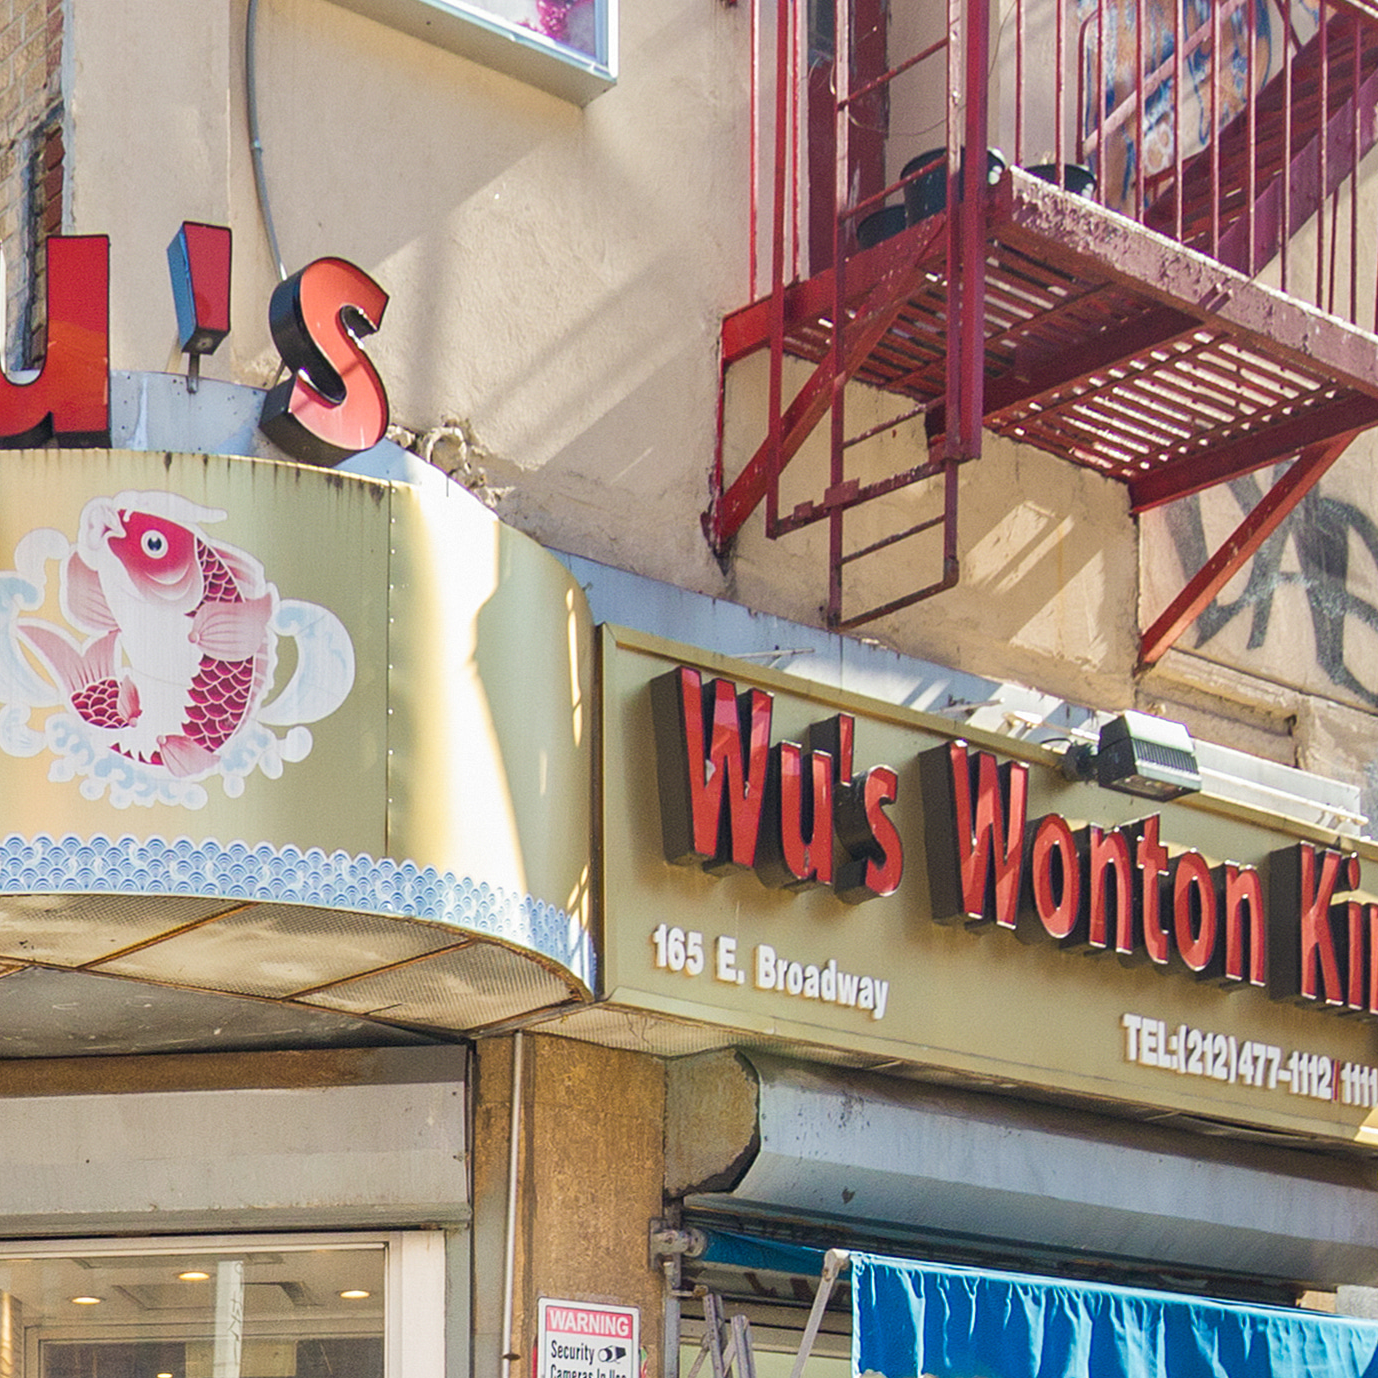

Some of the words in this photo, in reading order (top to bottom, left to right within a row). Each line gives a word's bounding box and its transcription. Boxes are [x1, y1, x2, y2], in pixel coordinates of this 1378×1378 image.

[652, 666, 904, 899] Wu's
[920, 739, 1265, 988] Wonton
[652, 924, 705, 974] 165
[715, 937, 747, 985] E.
[755, 945, 890, 1020] Broadway
[549, 1309, 629, 1336] WARNING
[551, 1339, 595, 1365] Security
